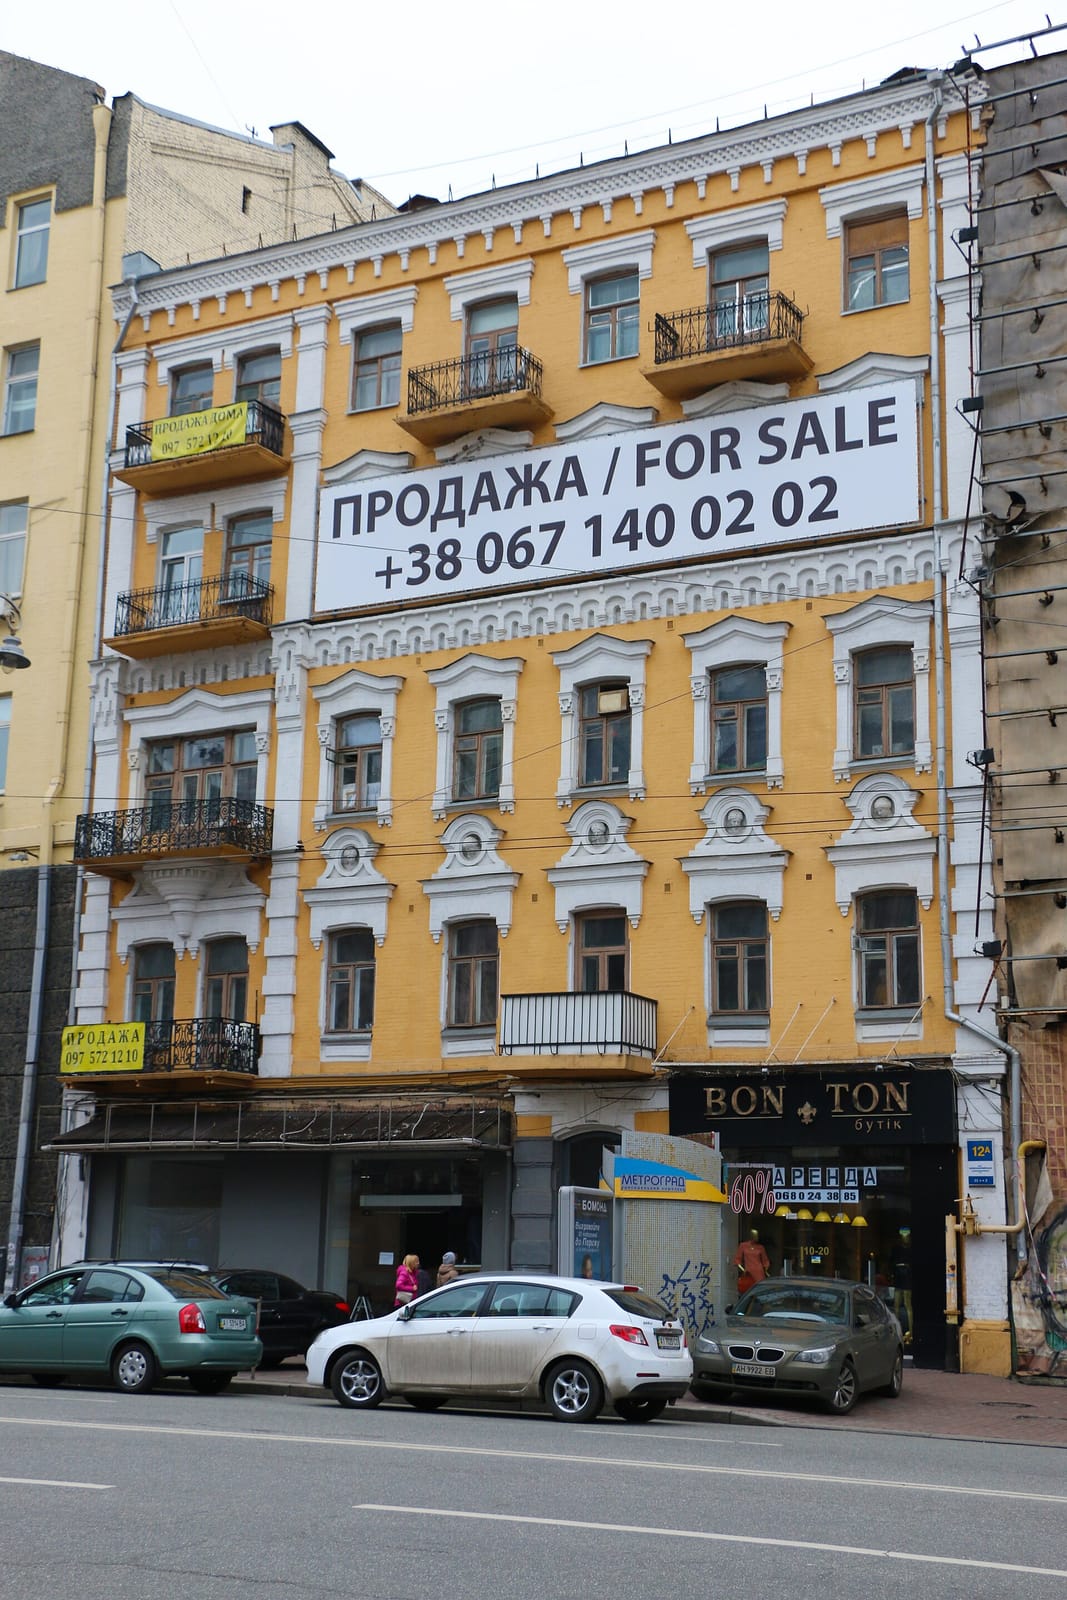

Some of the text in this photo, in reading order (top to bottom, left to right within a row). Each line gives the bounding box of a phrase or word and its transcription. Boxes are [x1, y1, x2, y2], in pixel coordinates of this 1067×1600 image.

[154, 414, 208, 434] ПРОДАЖА
[162, 441, 180, 455] 097
[186, 435, 204, 450] 572
[331, 453, 589, 539] ПРОДАЖА
[635, 426, 742, 488] FOR
[757, 396, 899, 465] SALE
[374, 475, 839, 590] +38 067 140 02 02
[66, 1029, 140, 1047] ПРОДАЖА
[65, 1049, 138, 1065] 097 572 12 10
[703, 1082, 911, 1116] BON TON
[854, 1118, 901, 1133] бутік
[621, 1174, 686, 1187] МЕТРОГРАД
[773, 1168, 877, 1186] АРЕНДА
